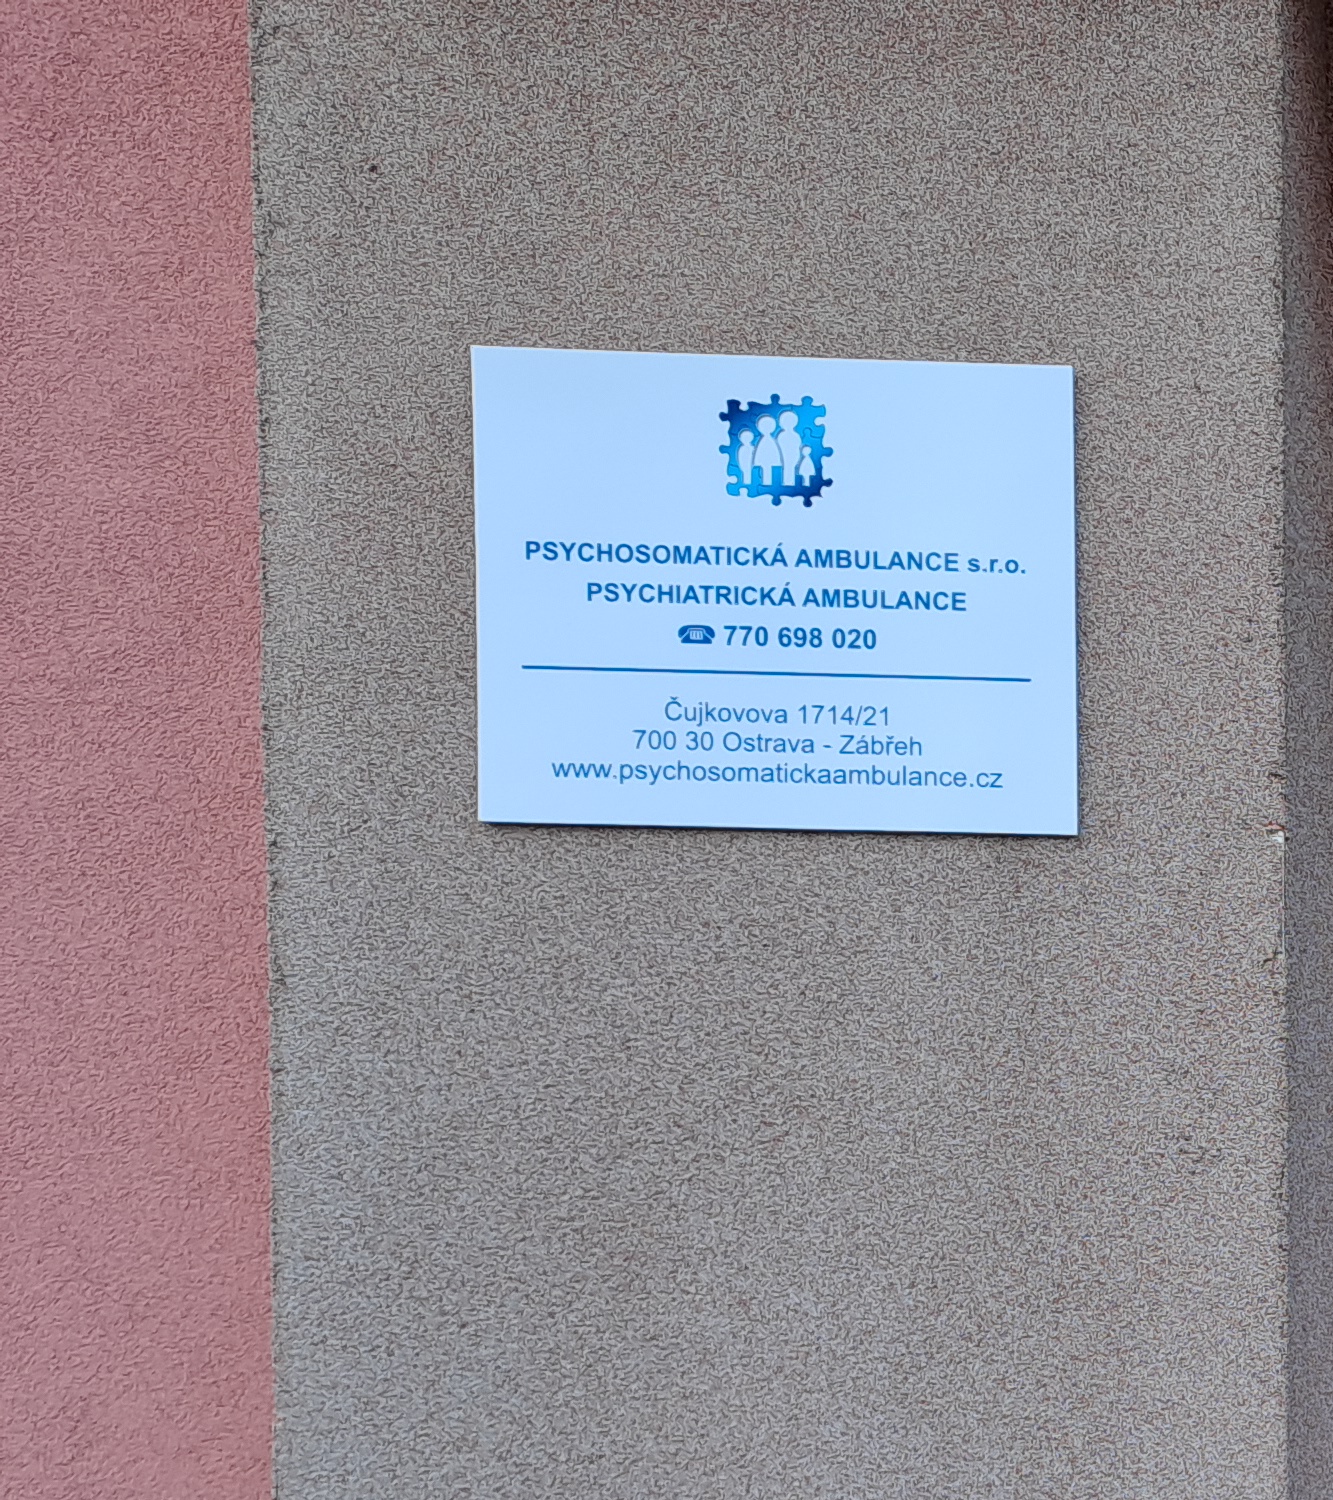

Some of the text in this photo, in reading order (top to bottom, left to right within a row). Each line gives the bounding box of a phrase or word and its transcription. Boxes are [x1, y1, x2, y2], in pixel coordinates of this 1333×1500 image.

[524, 540, 1027, 575] PSYCHOSOMATICKÁ AMBULANCE s.r.o.
[586, 582, 967, 612] PSYCHIATRICKÁ AMBULANCE
[723, 625, 877, 649] 770 698 020
[664, 695, 890, 727] Čujkovova 1714/21
[633, 730, 677, 751] 700
[685, 731, 714, 752] 30
[722, 732, 814, 754] Ostrava
[839, 733, 923, 756] Zábřeh
[552, 759, 1003, 791] www.psychosomatickaambulance.cz
